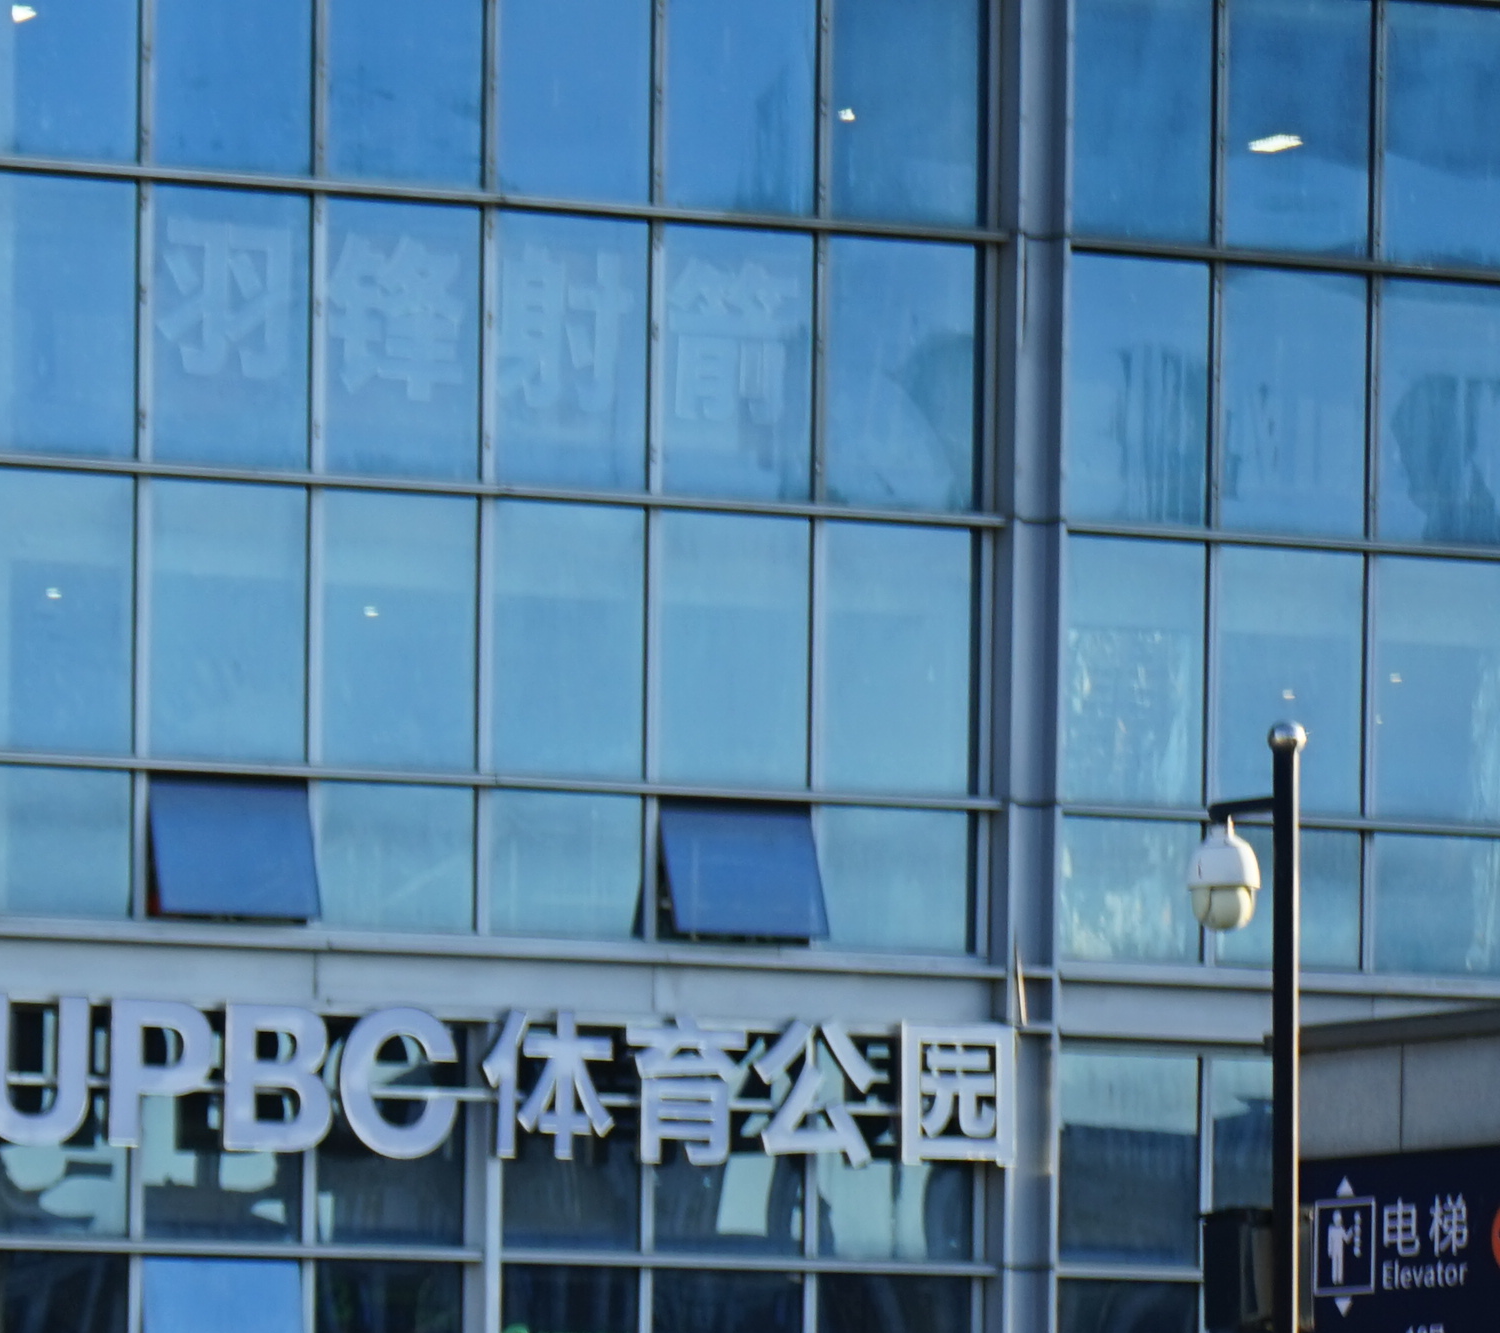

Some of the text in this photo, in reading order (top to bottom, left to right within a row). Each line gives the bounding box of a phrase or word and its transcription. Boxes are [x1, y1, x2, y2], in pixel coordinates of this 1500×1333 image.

[483, 1008, 1017, 1169] 体育公园
[1383, 1193, 1468, 1258] 电梯
[1382, 1259, 1467, 1291] Elevator
